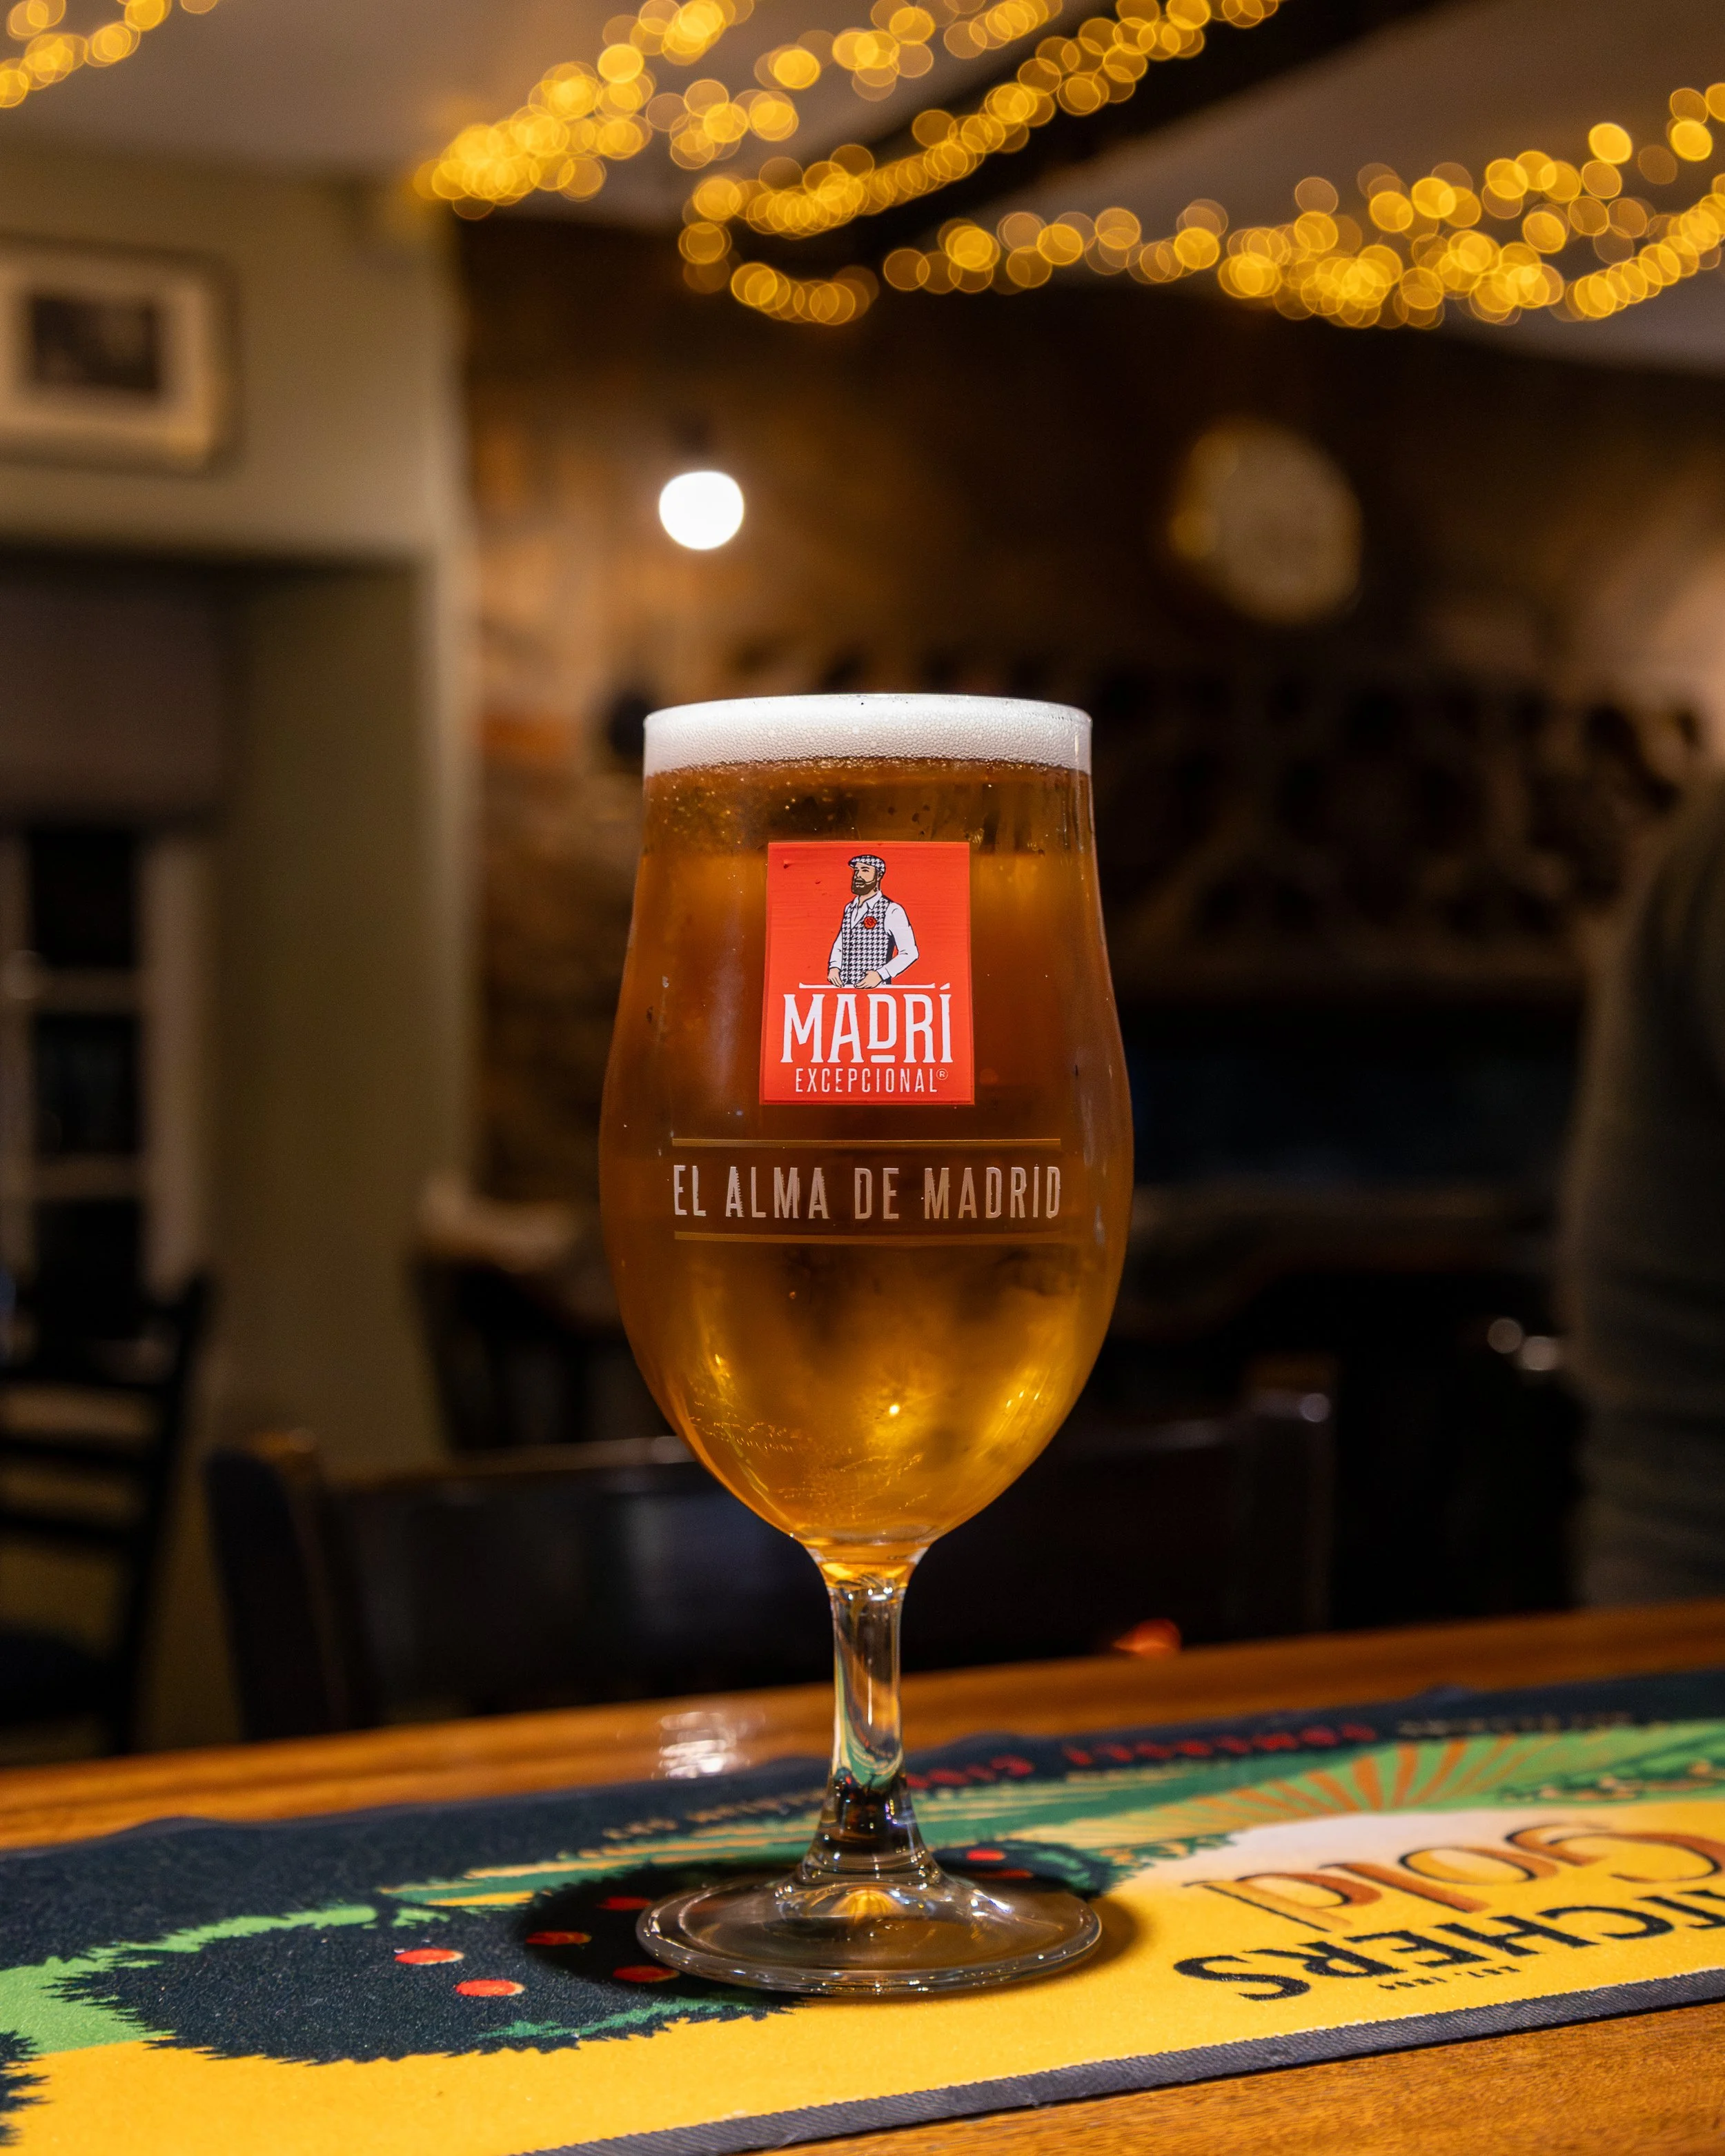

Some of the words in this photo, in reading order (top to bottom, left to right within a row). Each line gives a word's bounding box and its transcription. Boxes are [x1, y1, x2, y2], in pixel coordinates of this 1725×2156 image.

[780, 982, 954, 1063] MADRÍ
[673, 1165, 707, 1216] EL
[725, 1166, 829, 1218] ALMA
[854, 1167, 900, 1219] DE
[924, 1166, 1061, 1219] MADRID
